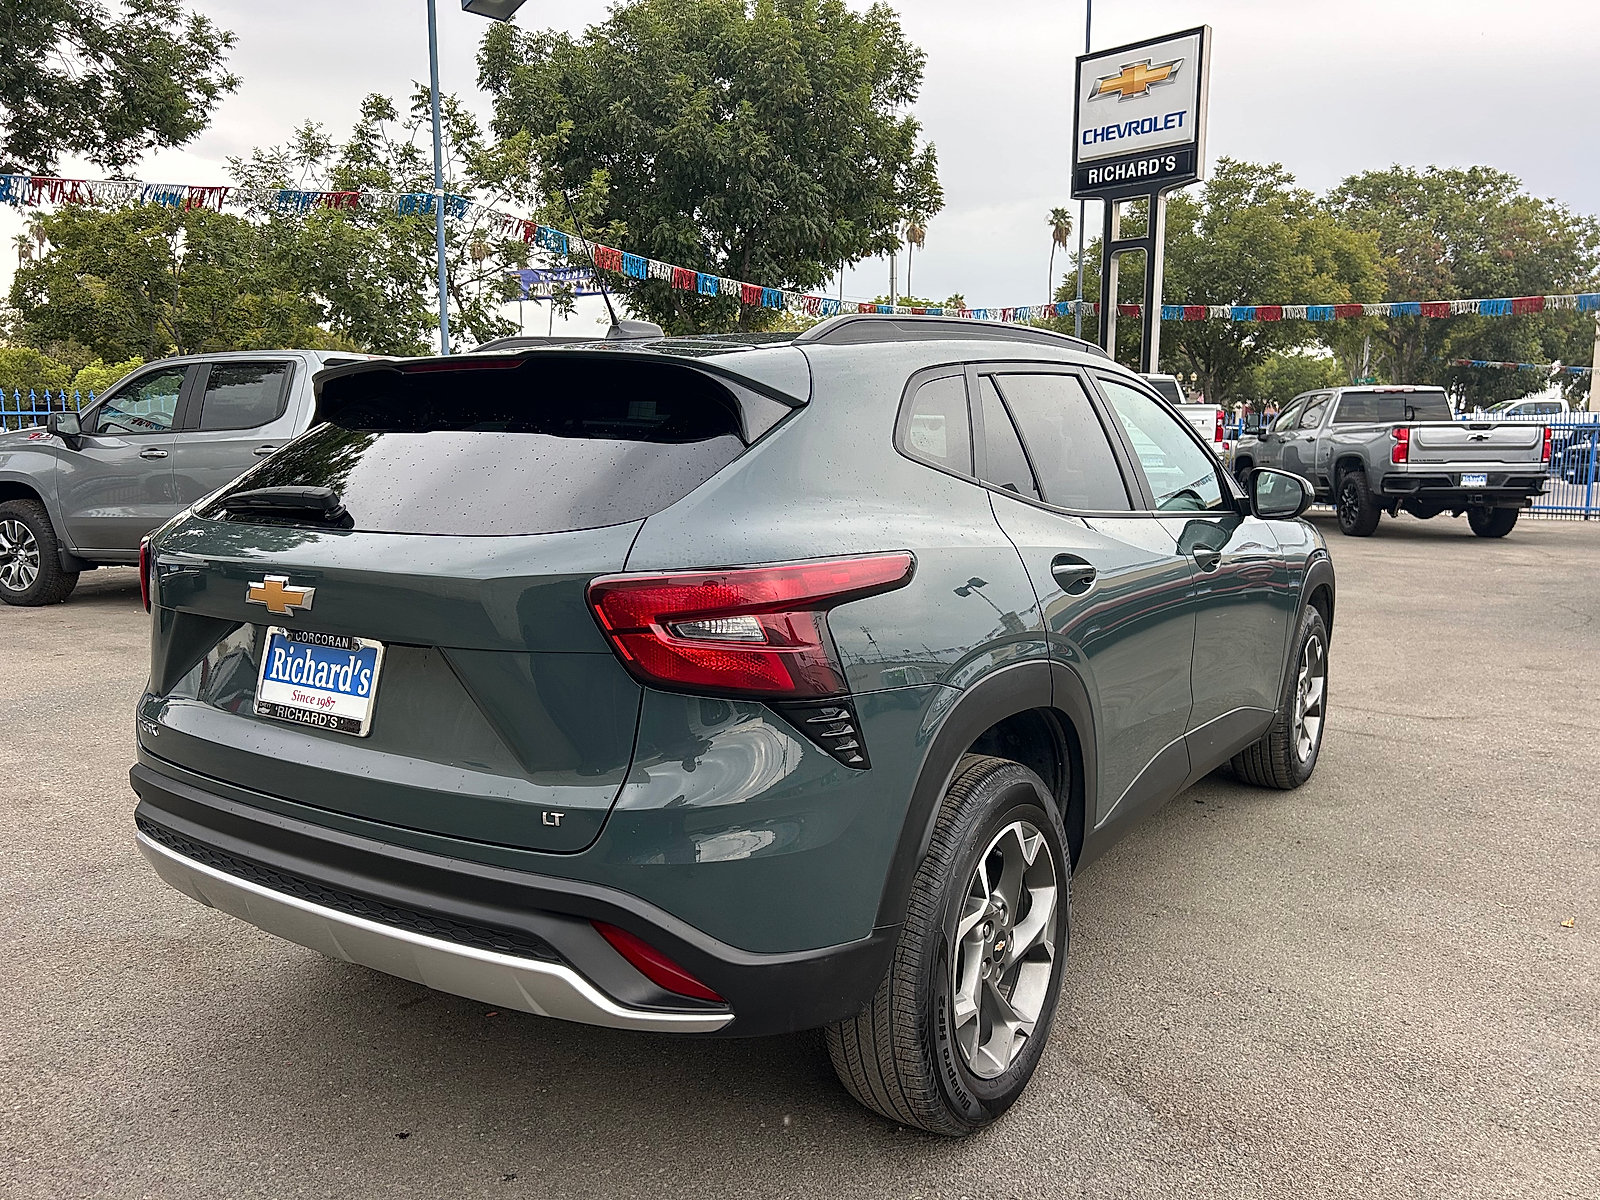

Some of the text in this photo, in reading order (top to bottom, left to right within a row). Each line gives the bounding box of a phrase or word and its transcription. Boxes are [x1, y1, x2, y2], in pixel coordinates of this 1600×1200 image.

[1082, 110, 1187, 145] CHEVROLET
[1088, 155, 1176, 184] RICHARD'S
[295, 631, 349, 649] CORCORAN
[269, 645, 371, 695] Richard's
[291, 689, 336, 711] Since 1987
[542, 811, 565, 826] LT
[938, 995, 972, 1110] Dynapro HP2
